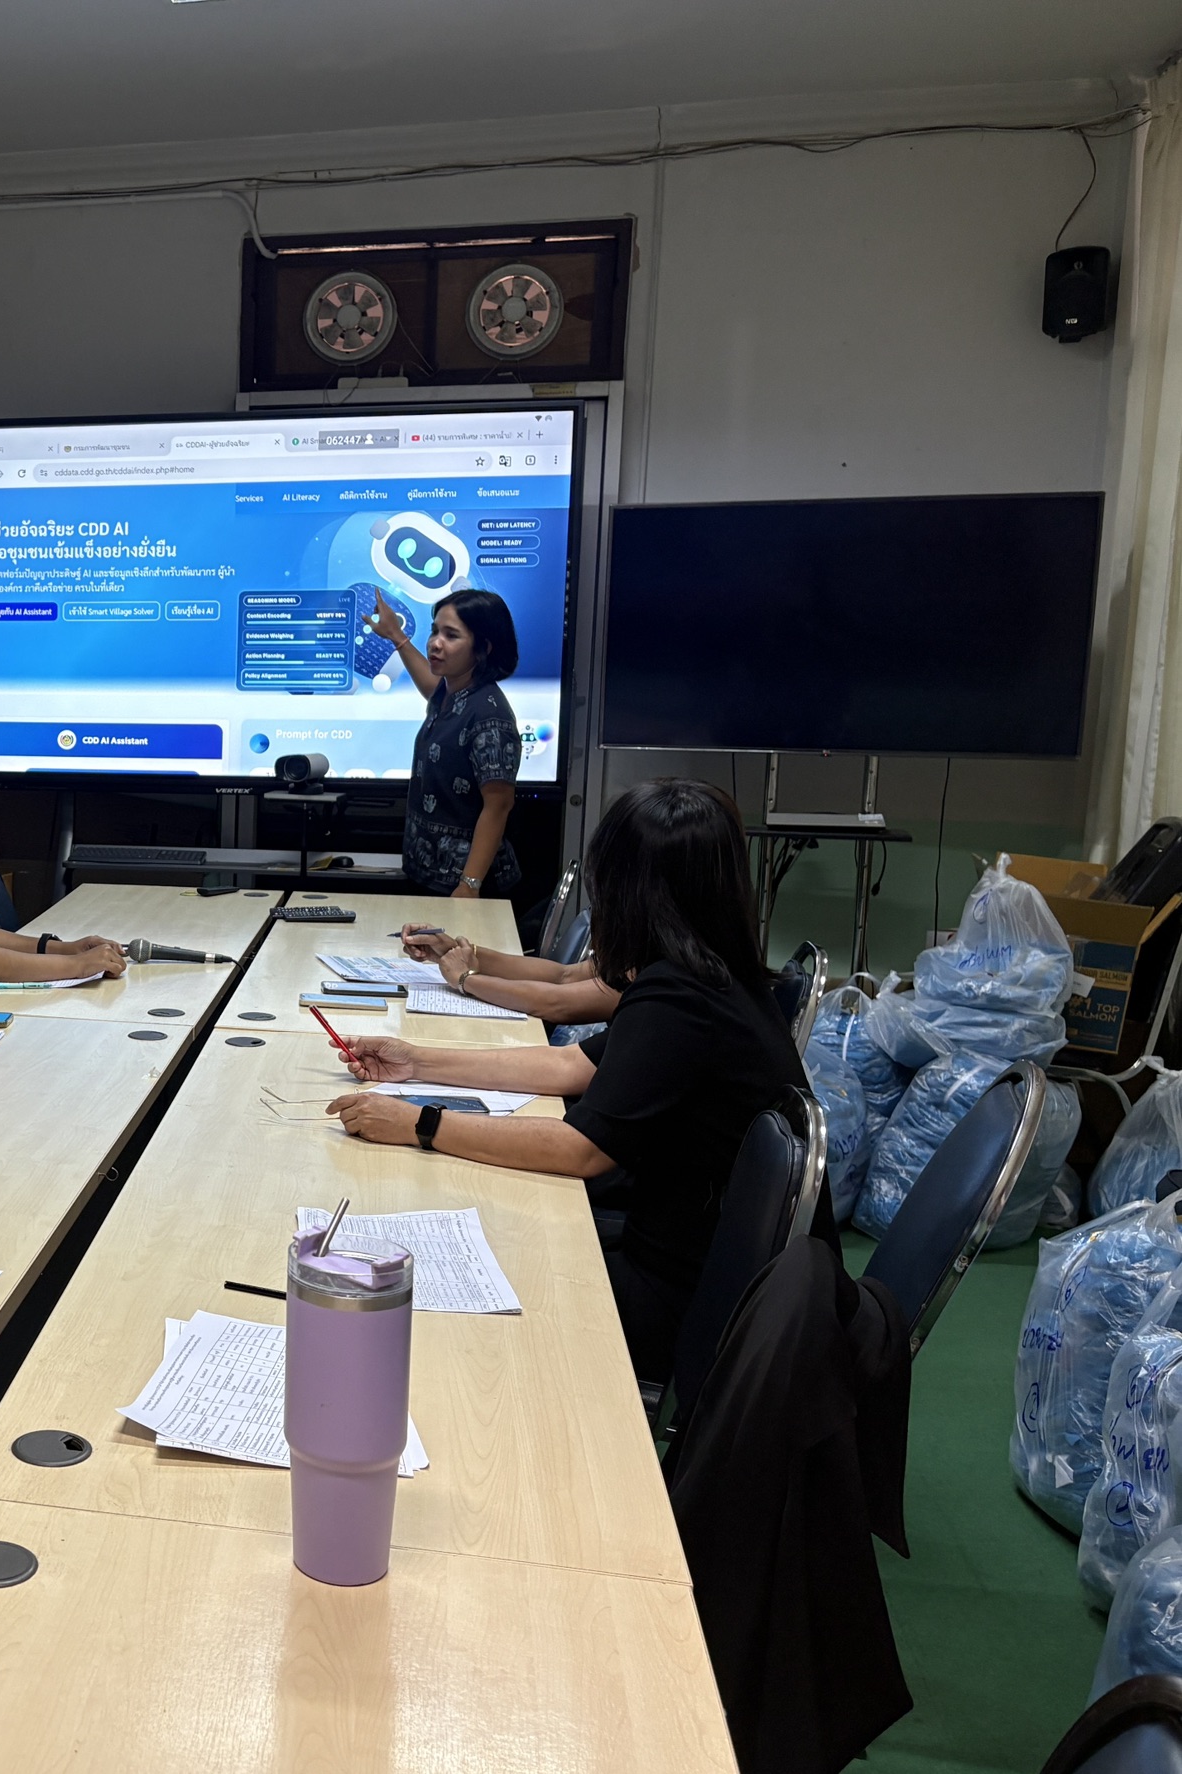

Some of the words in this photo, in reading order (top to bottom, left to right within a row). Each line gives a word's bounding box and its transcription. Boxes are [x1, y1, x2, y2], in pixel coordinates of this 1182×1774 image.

[326, 434, 361, 446] 062447
[422, 433, 436, 443] (44)
[54, 466, 195, 479] cddata.cdd.go.th/cddai/index.php#home
[235, 493, 264, 504] Services
[282, 493, 290, 501] AI
[291, 492, 320, 503] Literacy
[78, 522, 110, 537] CDD
[113, 521, 129, 535] AI
[510, 521, 536, 529] LATENCY
[83, 569, 92, 578] AI
[15, 608, 22, 616] AI
[23, 608, 53, 616] Assistant
[88, 608, 108, 616] Smart
[109, 607, 133, 617] Village
[133, 608, 155, 616] Solver
[206, 607, 214, 615] AI
[267, 612, 291, 620] Encoding
[263, 652, 285, 660] Planning
[82, 735, 101, 745] CDD
[102, 735, 110, 744] AI
[111, 735, 148, 746] Assistant
[275, 729, 311, 742] Prompt
[314, 729, 329, 740] for
[331, 729, 353, 740] CDD
[1096, 1003, 1120, 1013] TOP
[1068, 1008, 1117, 1022] SALMON
